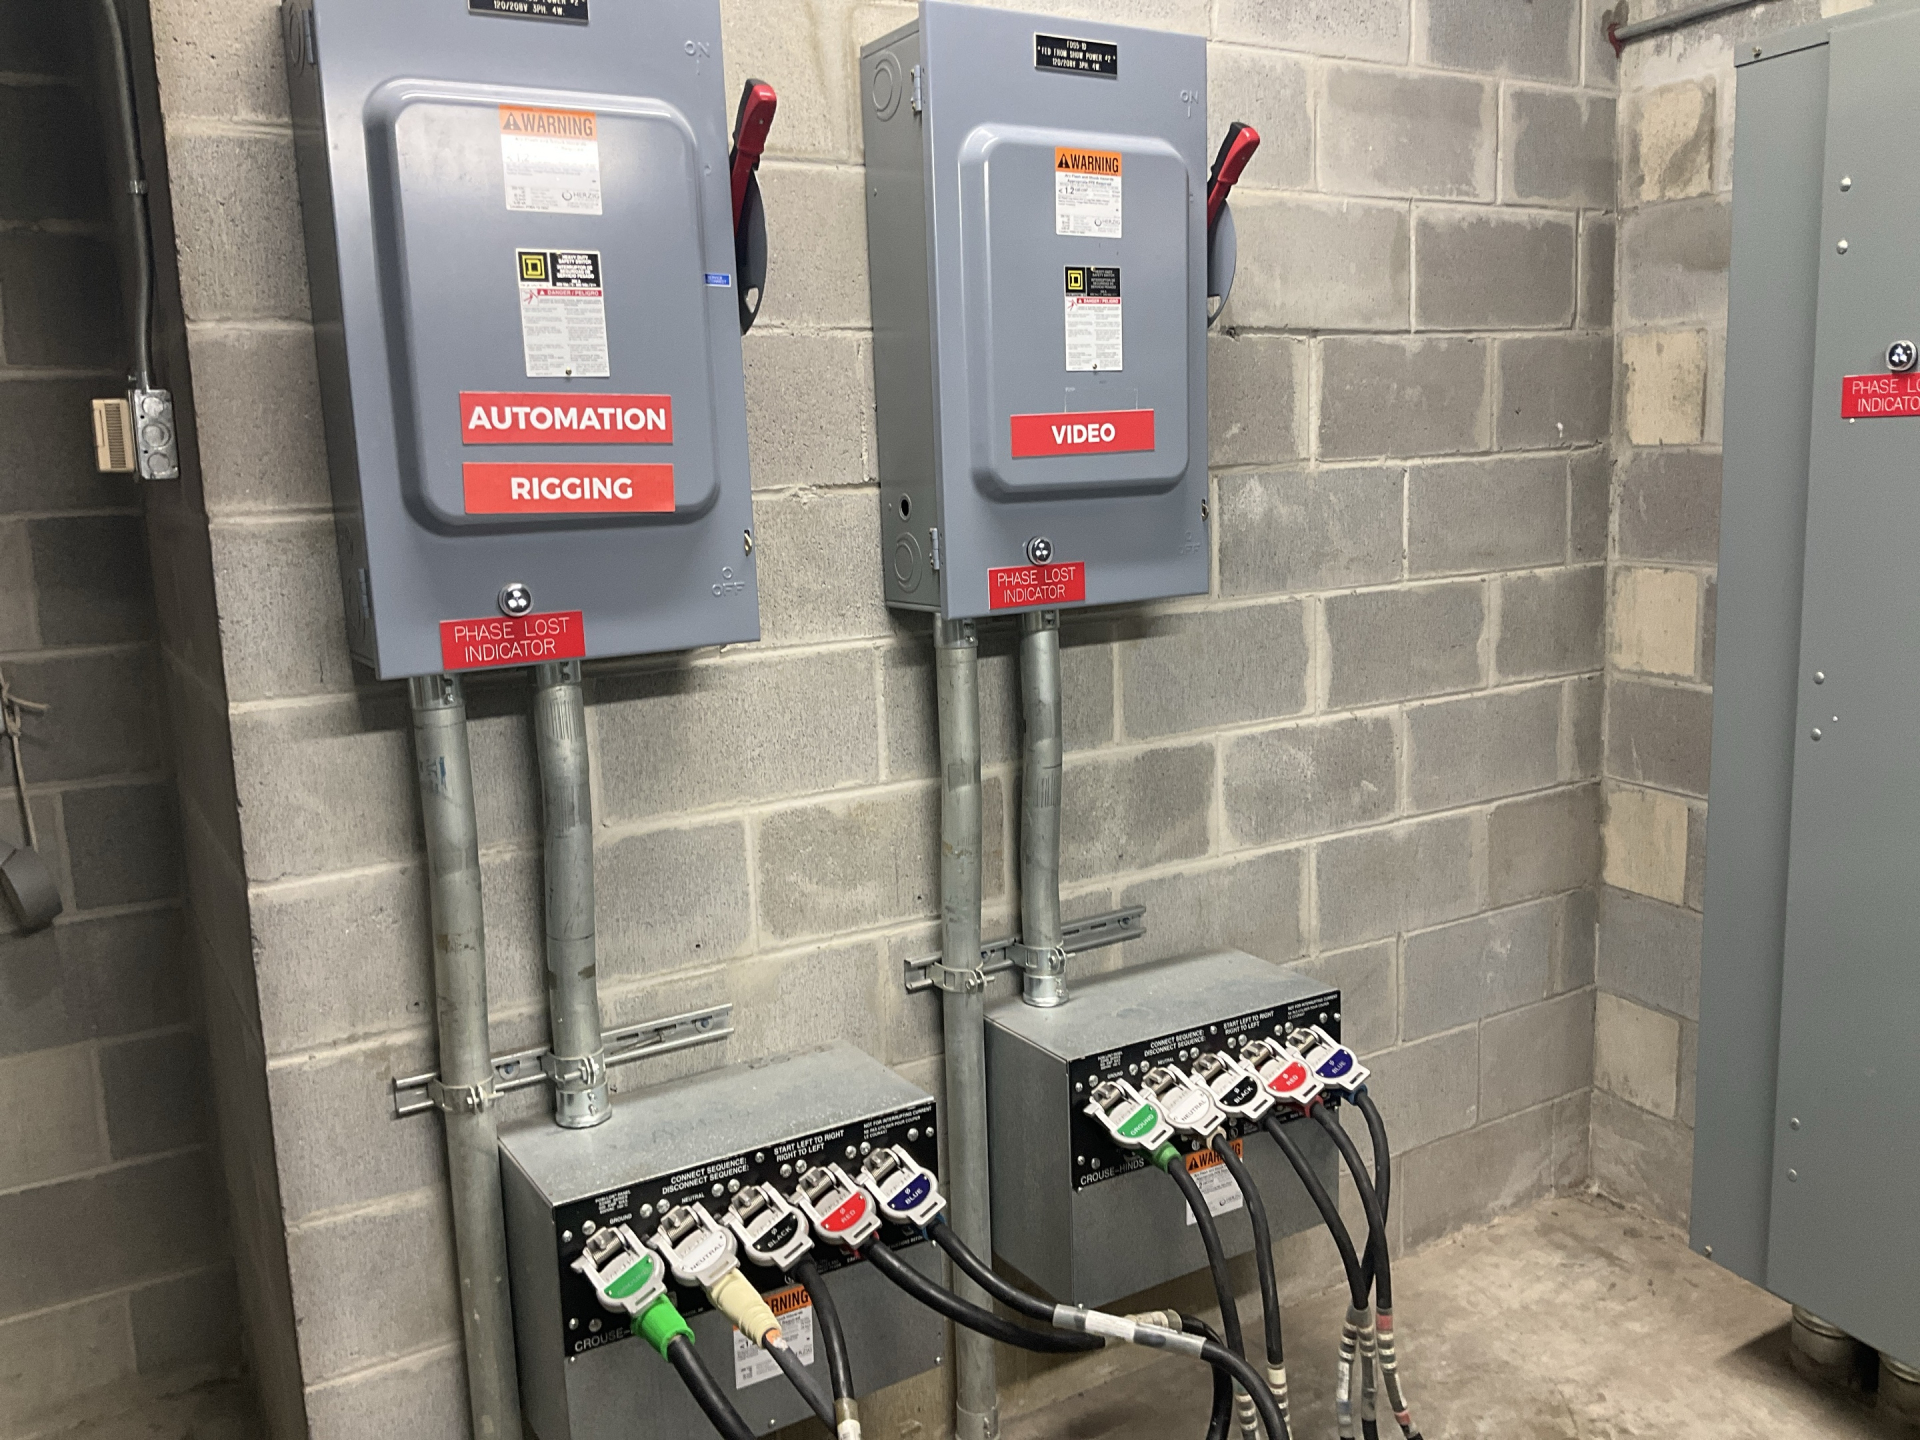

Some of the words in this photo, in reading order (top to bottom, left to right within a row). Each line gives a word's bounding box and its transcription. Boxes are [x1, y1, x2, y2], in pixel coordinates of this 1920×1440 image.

[685, 40, 710, 58] ON
[1086, 52, 1103, 62] POWER
[1180, 90, 1199, 105] ON
[521, 113, 593, 136] WARNING
[1070, 153, 1119, 173] WARNING
[1852, 379, 1899, 394] PHASE
[468, 406, 667, 430] AUTOMATION
[1051, 423, 1116, 444] VIDEO
[510, 477, 633, 500] RIGGING
[997, 570, 1038, 587] PHASE
[1045, 566, 1076, 583] LOST
[711, 581, 745, 597] OFF
[1004, 584, 1066, 603] INDICATOR
[454, 621, 515, 643] PHASE
[524, 617, 570, 637] LOST
[465, 638, 556, 663] INDICATOR
[1223, 1020, 1239, 1030] START
[1240, 1016, 1251, 1025] LEFT
[1259, 1010, 1274, 1020] RIGHT
[1225, 1026, 1240, 1035] RIGHT
[1248, 1020, 1260, 1029] LEFT
[1144, 1042, 1176, 1057] DISCONNECT
[1150, 1036, 1175, 1049] CONNECT
[1331, 1061, 1347, 1074] BLUE
[1286, 1074, 1299, 1087] RED
[1233, 1085, 1253, 1104] BLACK
[912, 1105, 932, 1116] CURRENT
[1181, 1099, 1207, 1121] NEUTRAL
[1130, 1113, 1154, 1136] GROUND
[774, 1143, 796, 1155] START
[797, 1138, 813, 1149] LEFT
[814, 1135, 823, 1143] TO
[824, 1130, 844, 1142] RIGHT
[776, 1150, 797, 1163] RIGHT
[798, 1148, 807, 1156] TO
[808, 1142, 824, 1153] LEFT
[1199, 1143, 1241, 1167] WARG
[671, 1168, 705, 1184] CONNECT
[1080, 1157, 1145, 1186] CROUSE-HINDS
[662, 1176, 708, 1195] DISCONNECT
[681, 1192, 705, 1204] NEUTRAL
[905, 1188, 923, 1205] BLUE
[609, 1213, 633, 1225] GROUND
[841, 1209, 856, 1224] RED
[767, 1225, 792, 1248] BLACK
[690, 1243, 724, 1271] NEUTRAL
[768, 1289, 809, 1313] RNING
[574, 1326, 633, 1352] CROUSE-
